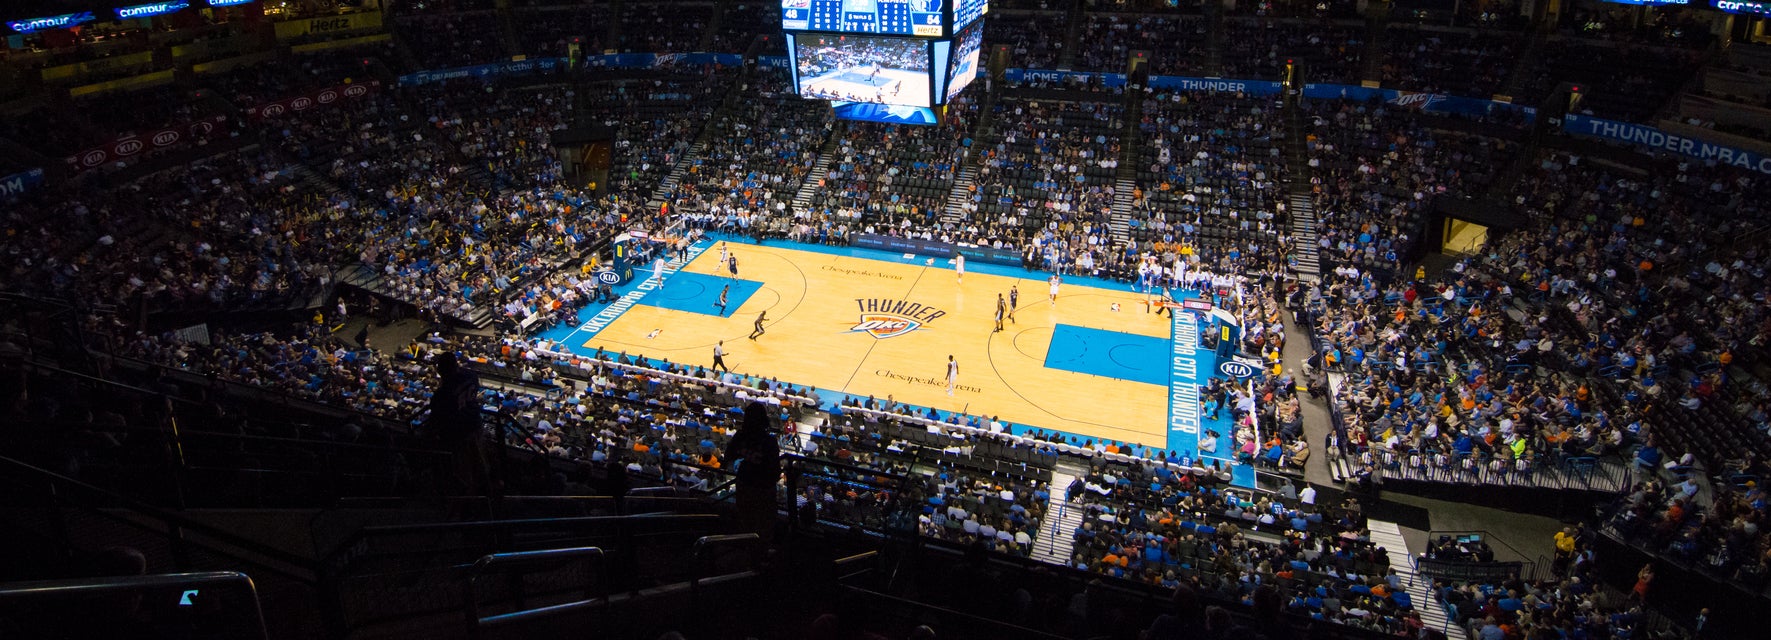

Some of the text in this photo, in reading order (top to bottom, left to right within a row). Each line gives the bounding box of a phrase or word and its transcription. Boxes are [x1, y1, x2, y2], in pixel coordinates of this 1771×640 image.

[785, 9, 798, 19] 48
[310, 18, 349, 33] Hertz
[1023, 72, 1059, 82] HOME
[1182, 79, 1246, 92] THUNDER
[580, 290, 647, 333] OKLAHOMA
[855, 298, 947, 323] THUNDER
[875, 368, 944, 387] Chesapeake
[1173, 356, 1197, 380] CITY
[1171, 381, 1197, 434] THUNDER
